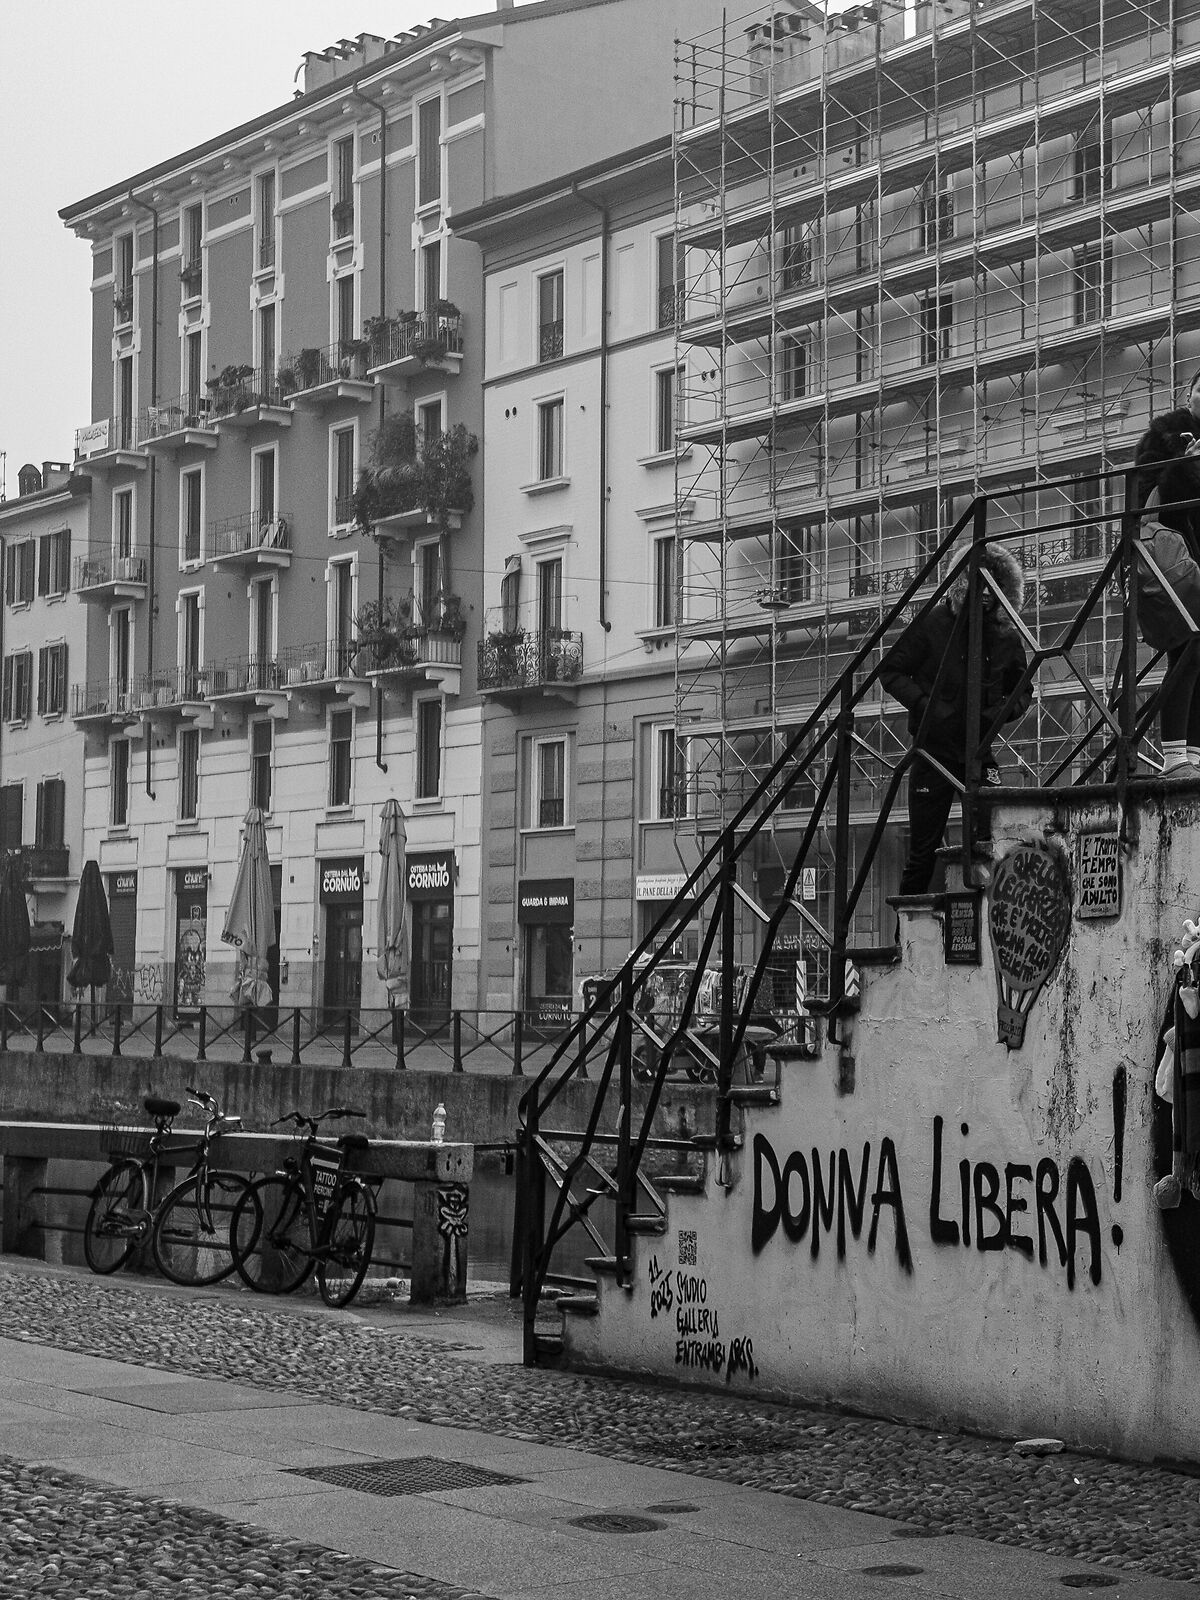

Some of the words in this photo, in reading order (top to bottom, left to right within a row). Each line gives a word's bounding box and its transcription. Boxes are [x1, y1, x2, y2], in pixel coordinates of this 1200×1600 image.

[1081, 857, 1116, 874] TEMPO
[323, 872, 361, 892] CORNUTO
[409, 867, 450, 889] CORNUTO
[643, 887, 656, 896] PANE
[656, 886, 673, 896] DELLA
[1080, 889, 1118, 906] ADULTO
[316, 1170, 337, 1186] TATTOO
[751, 1131, 914, 1276] DONNA
[676, 1271, 707, 1305] STUDIO
